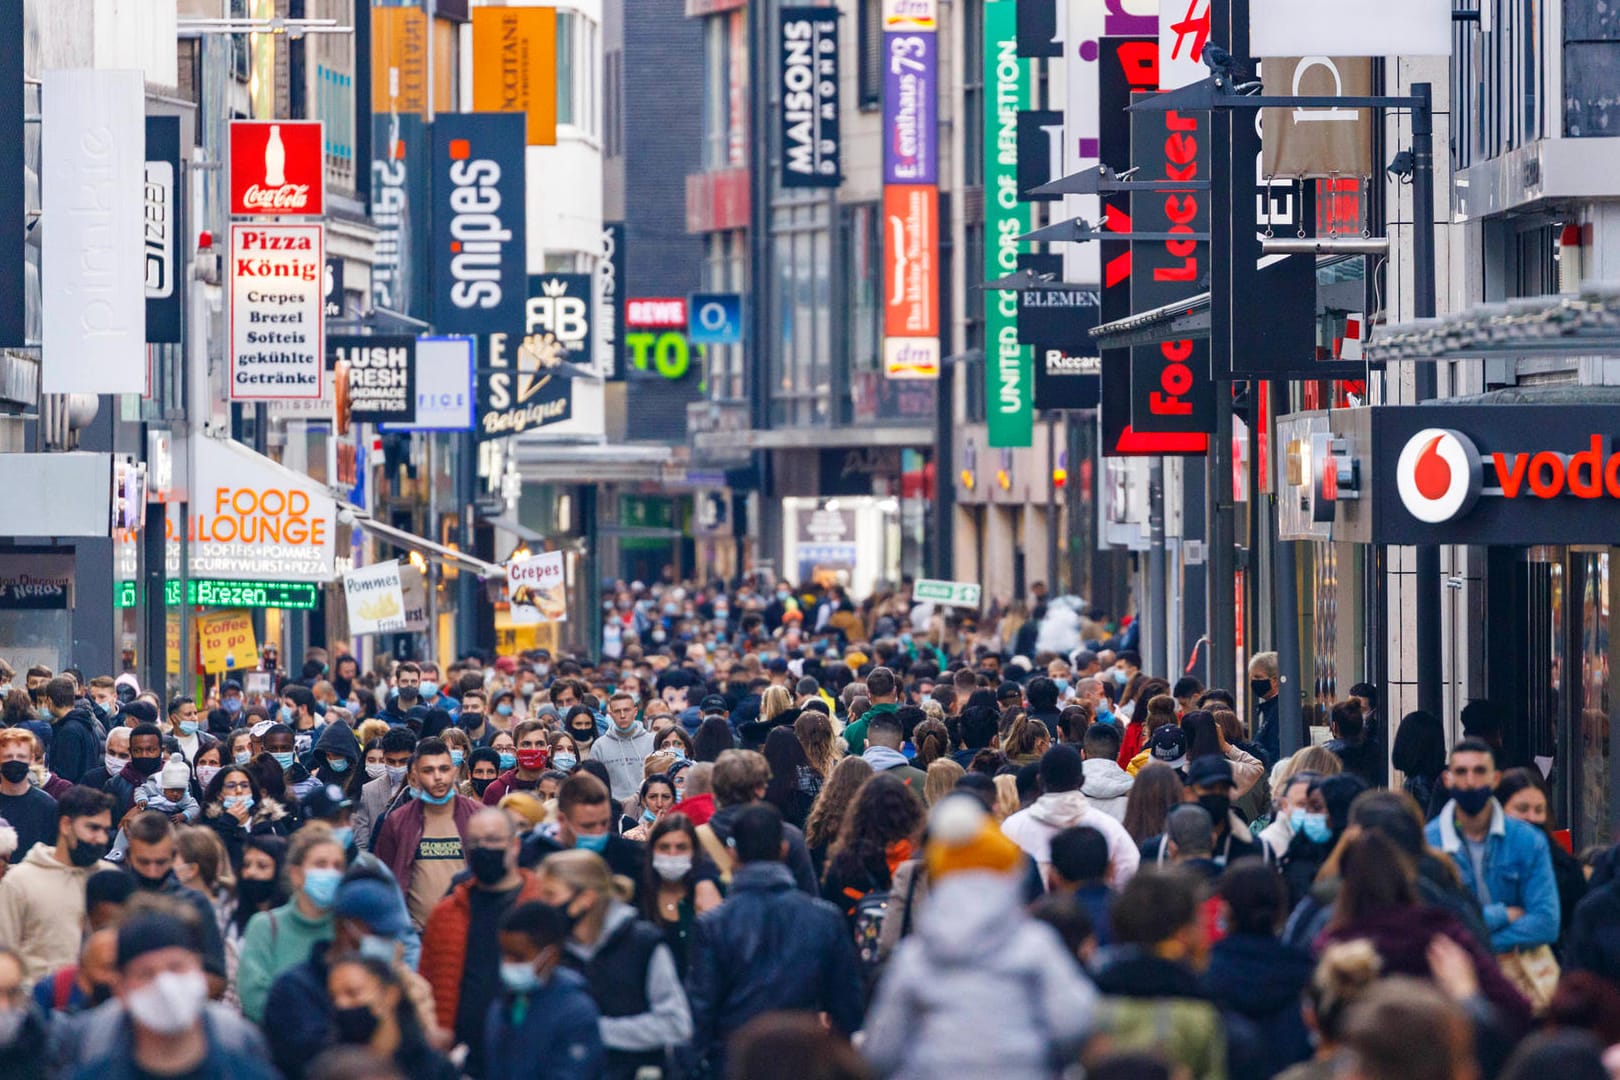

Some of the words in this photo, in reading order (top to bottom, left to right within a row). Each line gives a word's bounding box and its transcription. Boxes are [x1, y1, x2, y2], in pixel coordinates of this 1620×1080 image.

[820, 21, 836, 119] MONDE
[785, 21, 812, 174] MAISONS
[820, 140, 836, 174] DU
[997, 174, 1018, 209] OF
[1154, 110, 1197, 281] Locker
[242, 231, 311, 250] Pizza
[451, 160, 511, 308] snipes
[237, 259, 317, 281] König
[247, 291, 305, 304] Crepes
[250, 311, 303, 323] Brezel
[628, 301, 682, 326] REWE
[247, 331, 306, 343] Softeis
[239, 352, 314, 366] gekühlte
[625, 332, 689, 378] TO
[896, 341, 931, 362] dm
[236, 371, 317, 384] Getränke
[350, 368, 407, 387] RESH
[998, 326, 1022, 413] UNITED
[1149, 339, 1193, 415] Foo
[483, 398, 566, 433] Belgique
[216, 488, 310, 516] FOOD
[198, 514, 325, 545] LOUNGE
[511, 564, 560, 582] Crepes
[198, 583, 267, 602] Brezen
[347, 575, 399, 594] Pommes
[203, 619, 249, 636] Coffee
[206, 638, 221, 649] to
[228, 634, 246, 648] go
